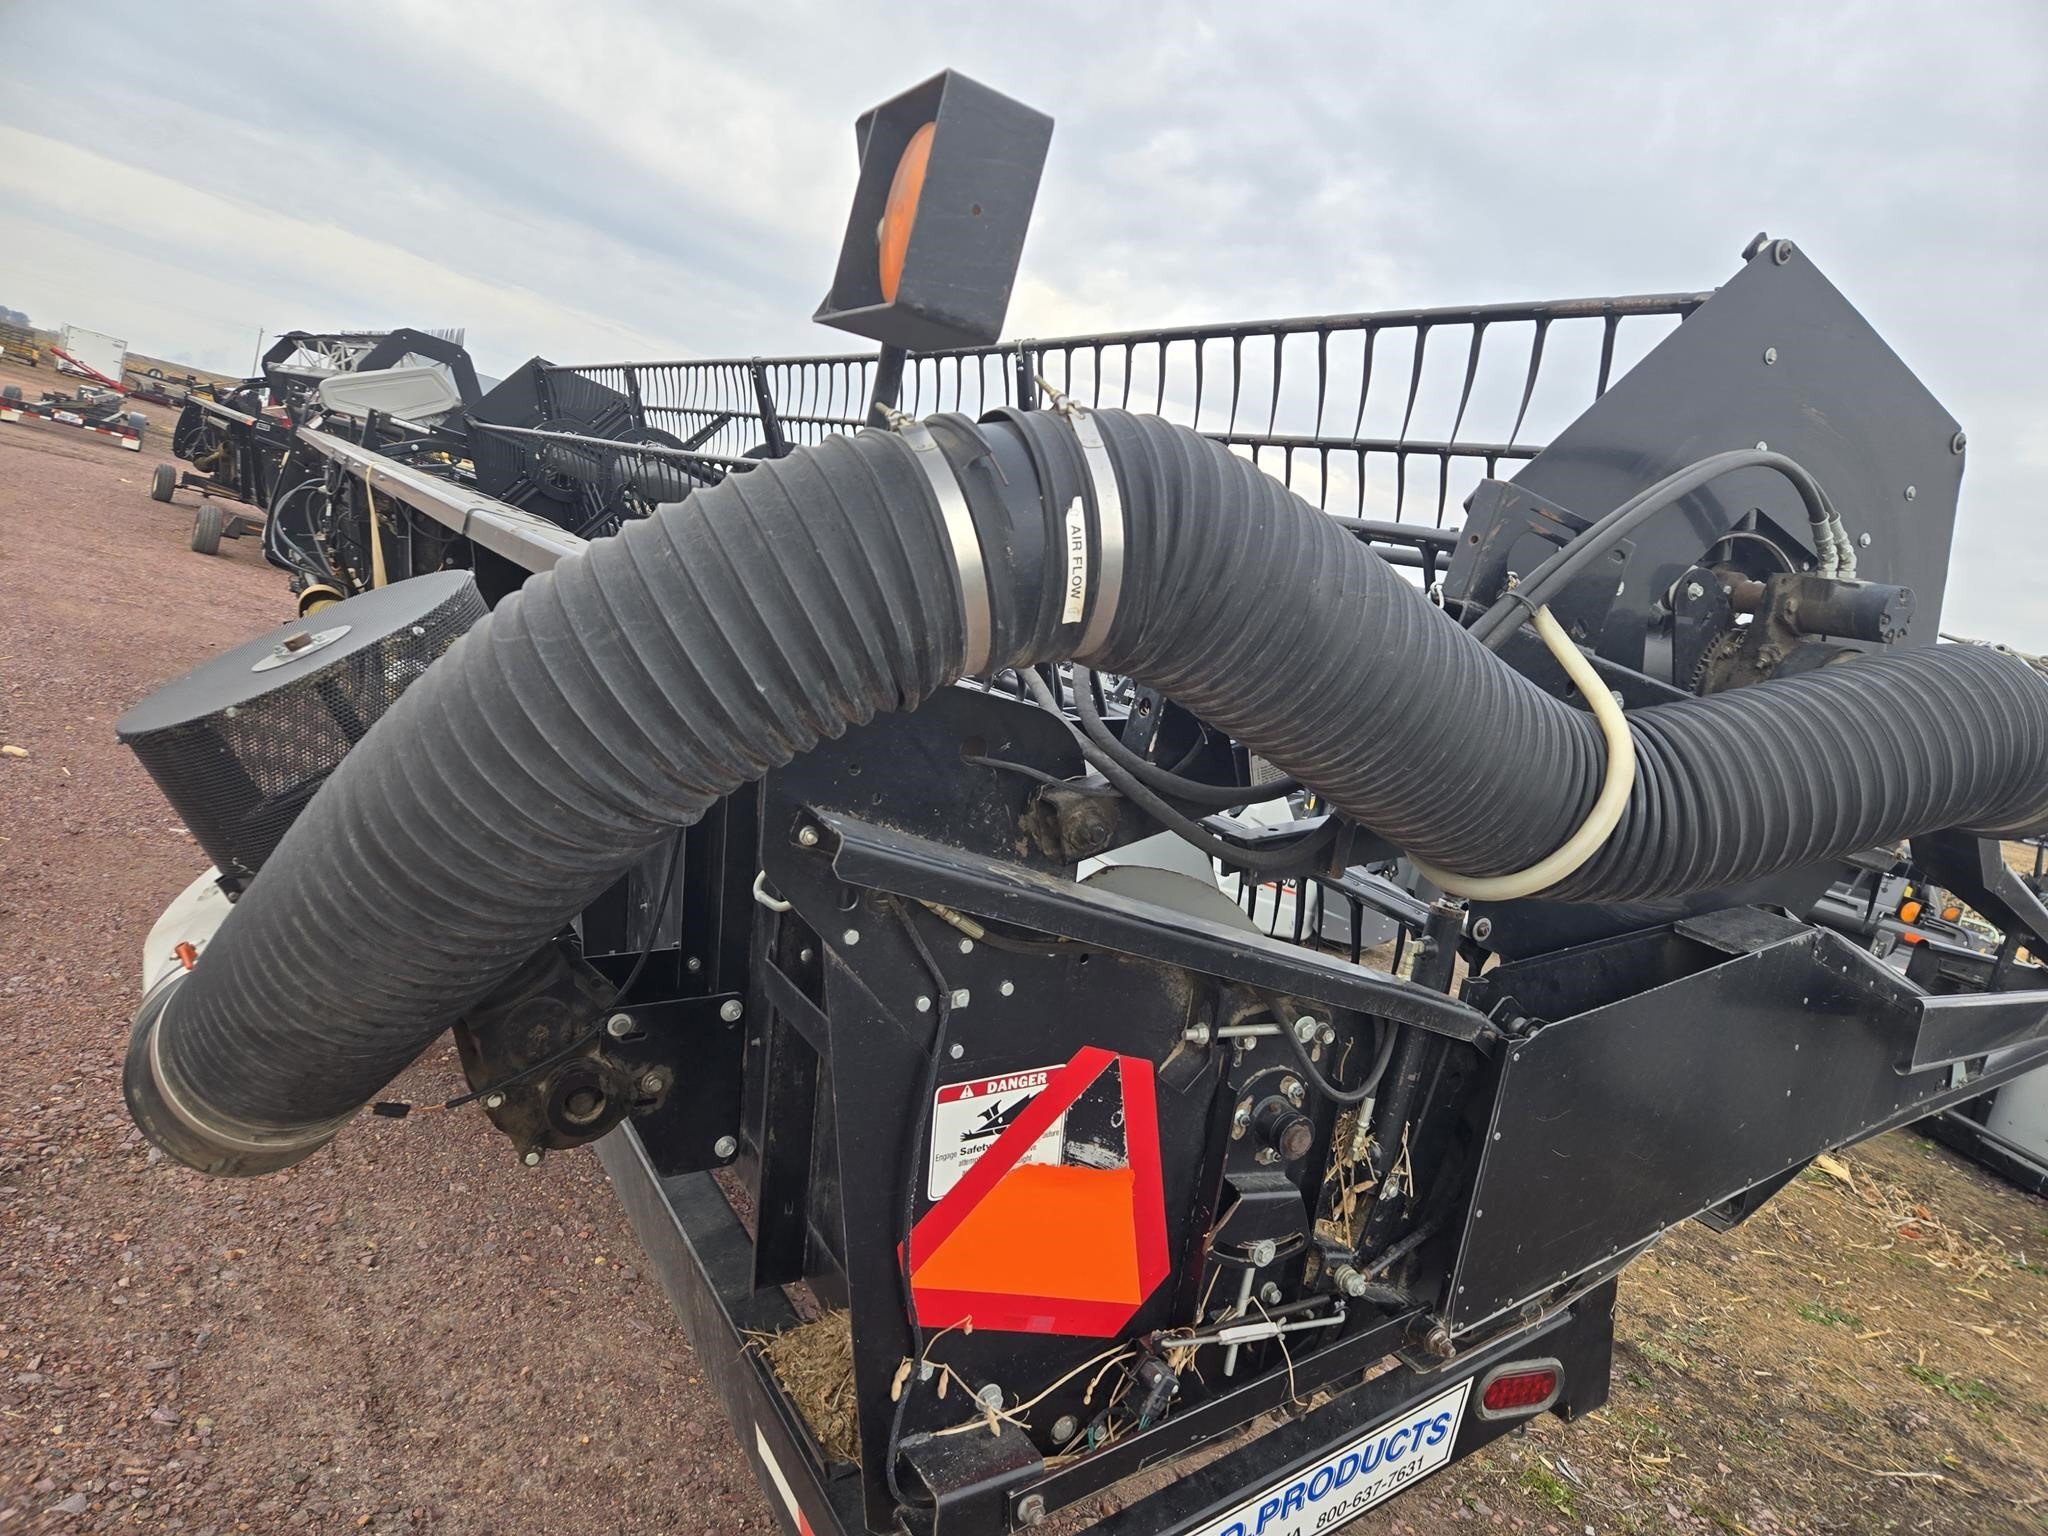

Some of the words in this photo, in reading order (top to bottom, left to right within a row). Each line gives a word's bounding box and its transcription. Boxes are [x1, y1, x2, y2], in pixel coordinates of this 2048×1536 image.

[1070, 525, 1083, 551] AIR
[1070, 556, 1083, 599] FLOW
[986, 1072, 1048, 1094] DANGER
[935, 1151, 958, 1163] Engage
[1256, 1412, 1453, 1536] PRODUCTS
[1315, 1455, 1425, 1529] 800-637-7631
